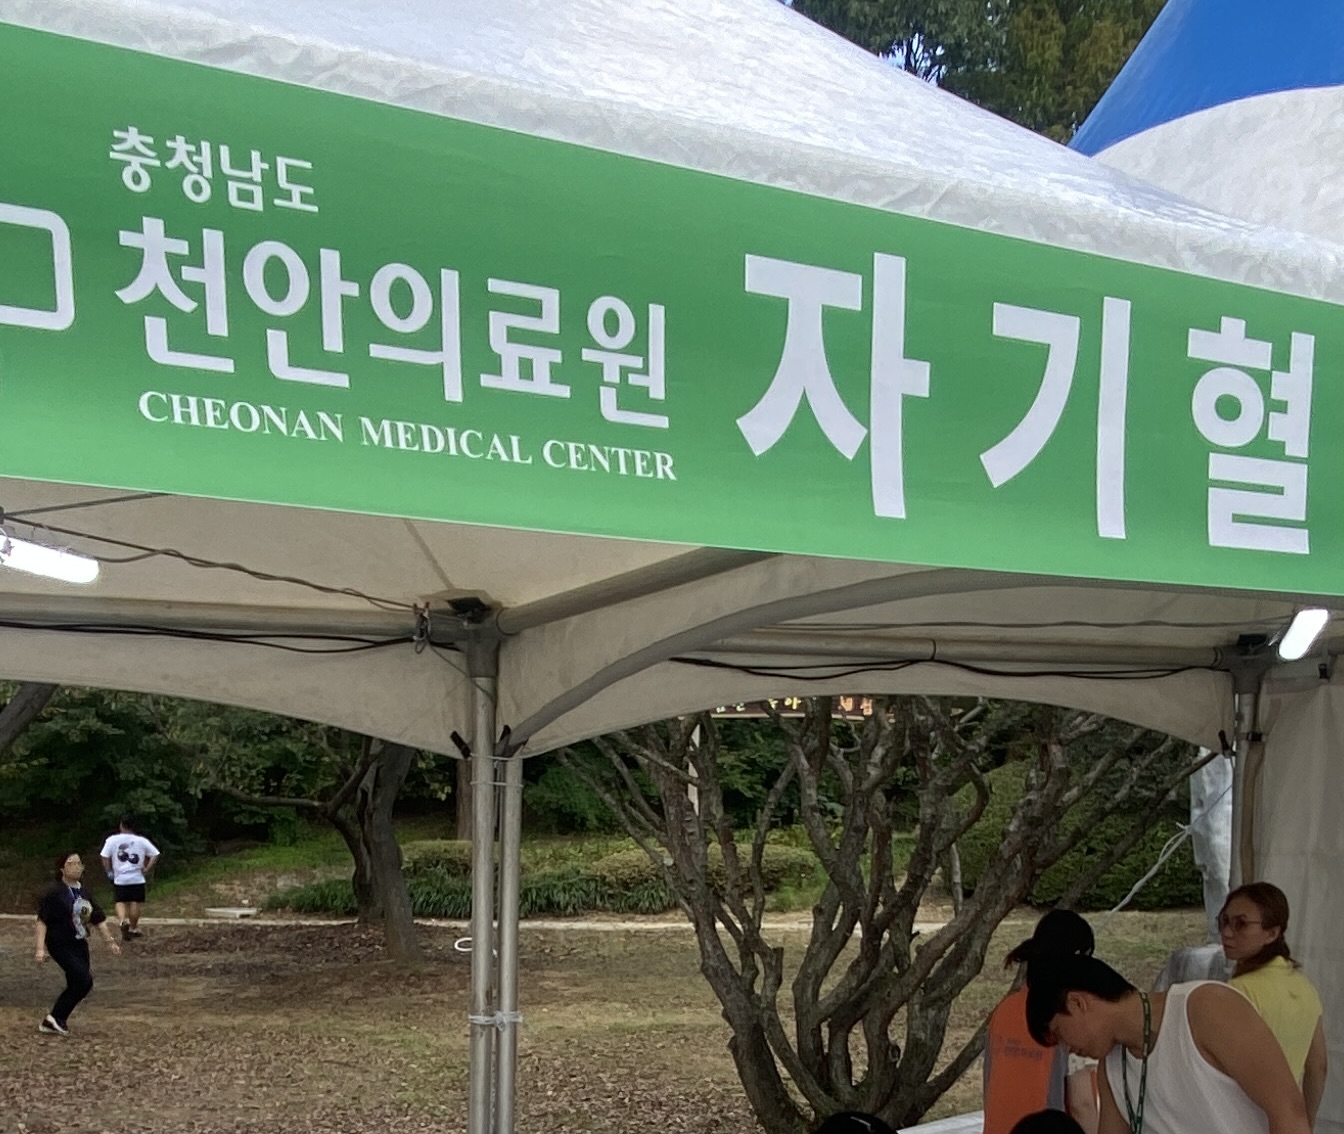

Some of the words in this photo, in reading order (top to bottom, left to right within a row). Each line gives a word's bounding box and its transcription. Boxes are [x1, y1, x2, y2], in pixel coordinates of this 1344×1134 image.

[110, 127, 318, 211] 충청남도
[115, 217, 669, 428] 천안의료원
[139, 391, 343, 442] CHEONAN
[360, 417, 532, 463] MEDICAL
[543, 440, 676, 480] CENTER
